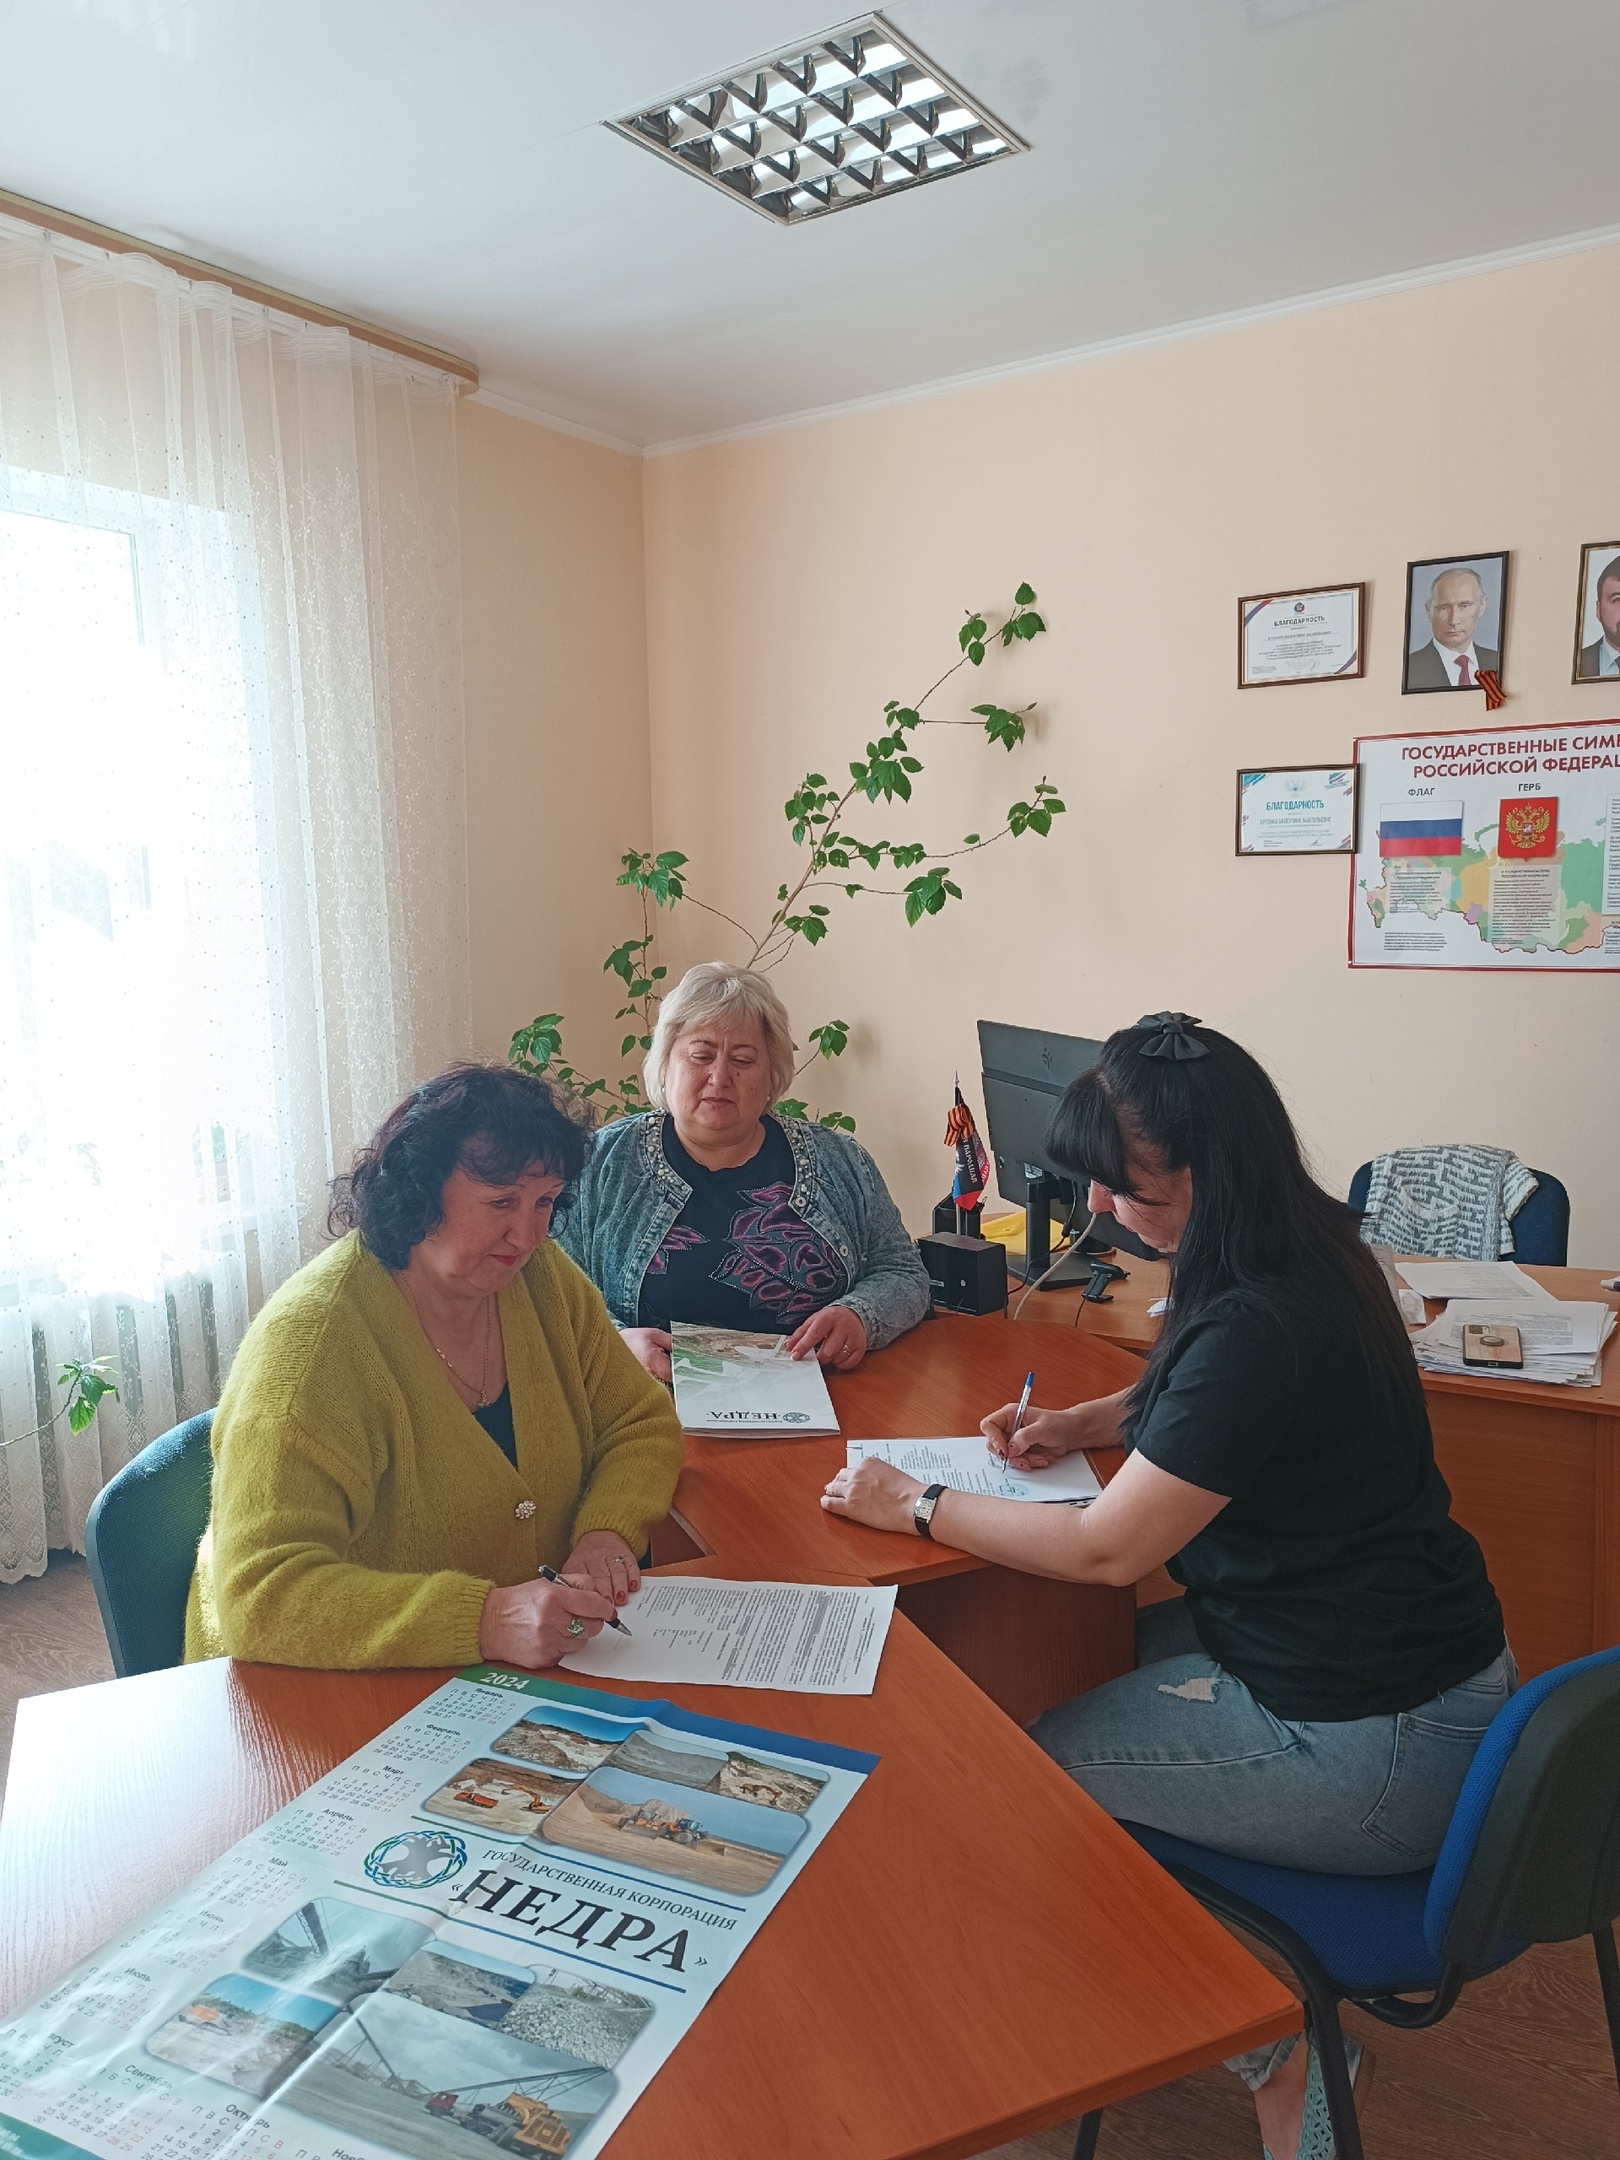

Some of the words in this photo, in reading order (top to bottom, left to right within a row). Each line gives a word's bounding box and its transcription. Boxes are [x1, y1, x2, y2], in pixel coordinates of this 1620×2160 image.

[1273, 615, 1325, 627] БЛАГОДАРНОСТЬ
[1401, 737, 1568, 761] ГОСУДАРСТВЕННЫЕ
[1413, 755, 1538, 778] РОССИЙСКОЙ
[1407, 787, 1435, 797] ФЛАГ
[1518, 782, 1541, 792] ГЕРБ
[1266, 799, 1325, 811] БЛАГОДАРНОСТЬ
[480, 1672, 530, 1690] 2024
[475, 1687, 504, 1699] Январь
[426, 1724, 461, 1736] Февраль
[382, 1765, 406, 1775] Март
[321, 1808, 355, 1821] Апрель
[268, 1857, 289, 1867] Май
[481, 1849, 627, 1899] ГОСУДАРСТВЕННАЯ
[628, 1890, 739, 1932] КОРПОРАЦИЯ
[199, 1909, 224, 1923] Июнь
[448, 1868, 709, 1973] «НЕДРА»
[124, 1967, 151, 1982] Июль
[125, 2064, 173, 2089] Сентябрь
